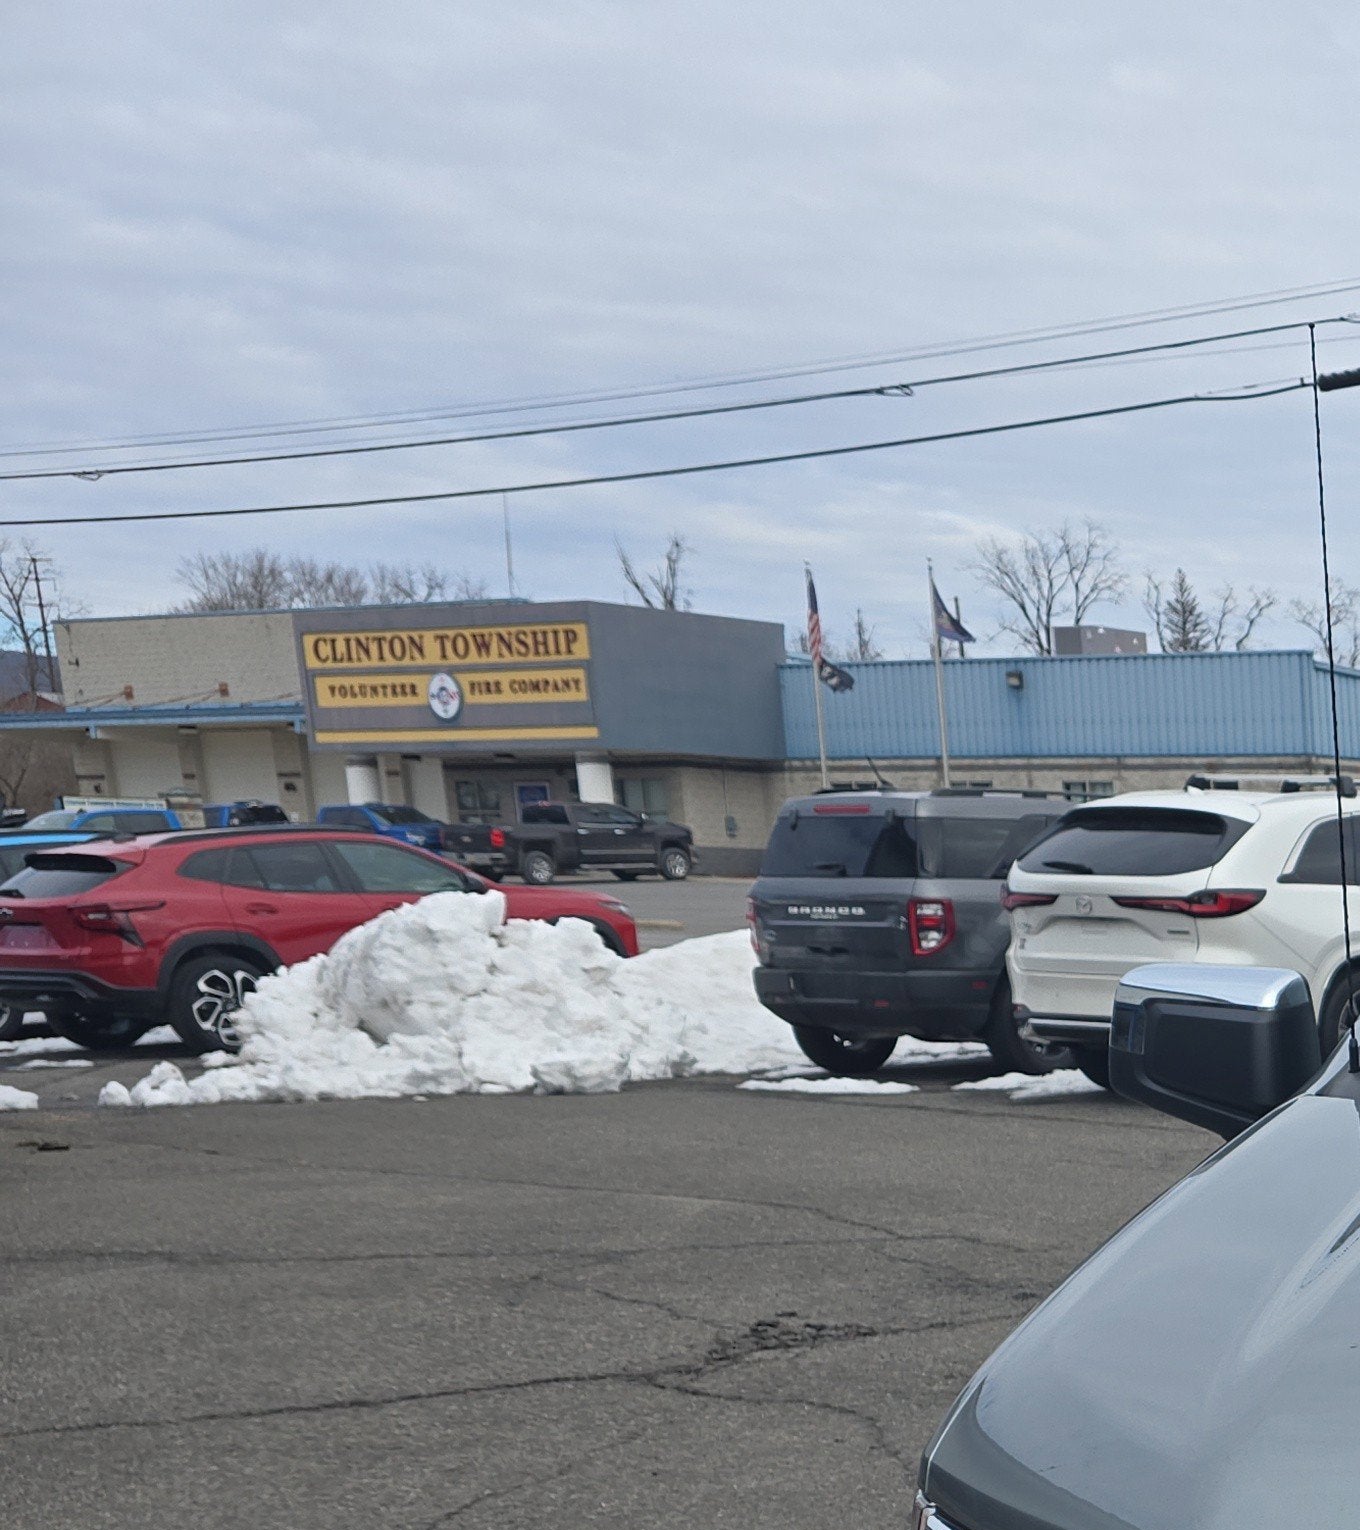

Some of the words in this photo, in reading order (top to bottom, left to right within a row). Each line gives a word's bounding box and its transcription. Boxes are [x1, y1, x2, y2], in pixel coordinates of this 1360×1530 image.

[313, 634, 425, 664] CLINTON
[434, 628, 578, 661] TOWNSHIP
[328, 683, 419, 699] VOLUNTEER
[468, 680, 504, 695] FIRE
[509, 677, 582, 694] COMPANY
